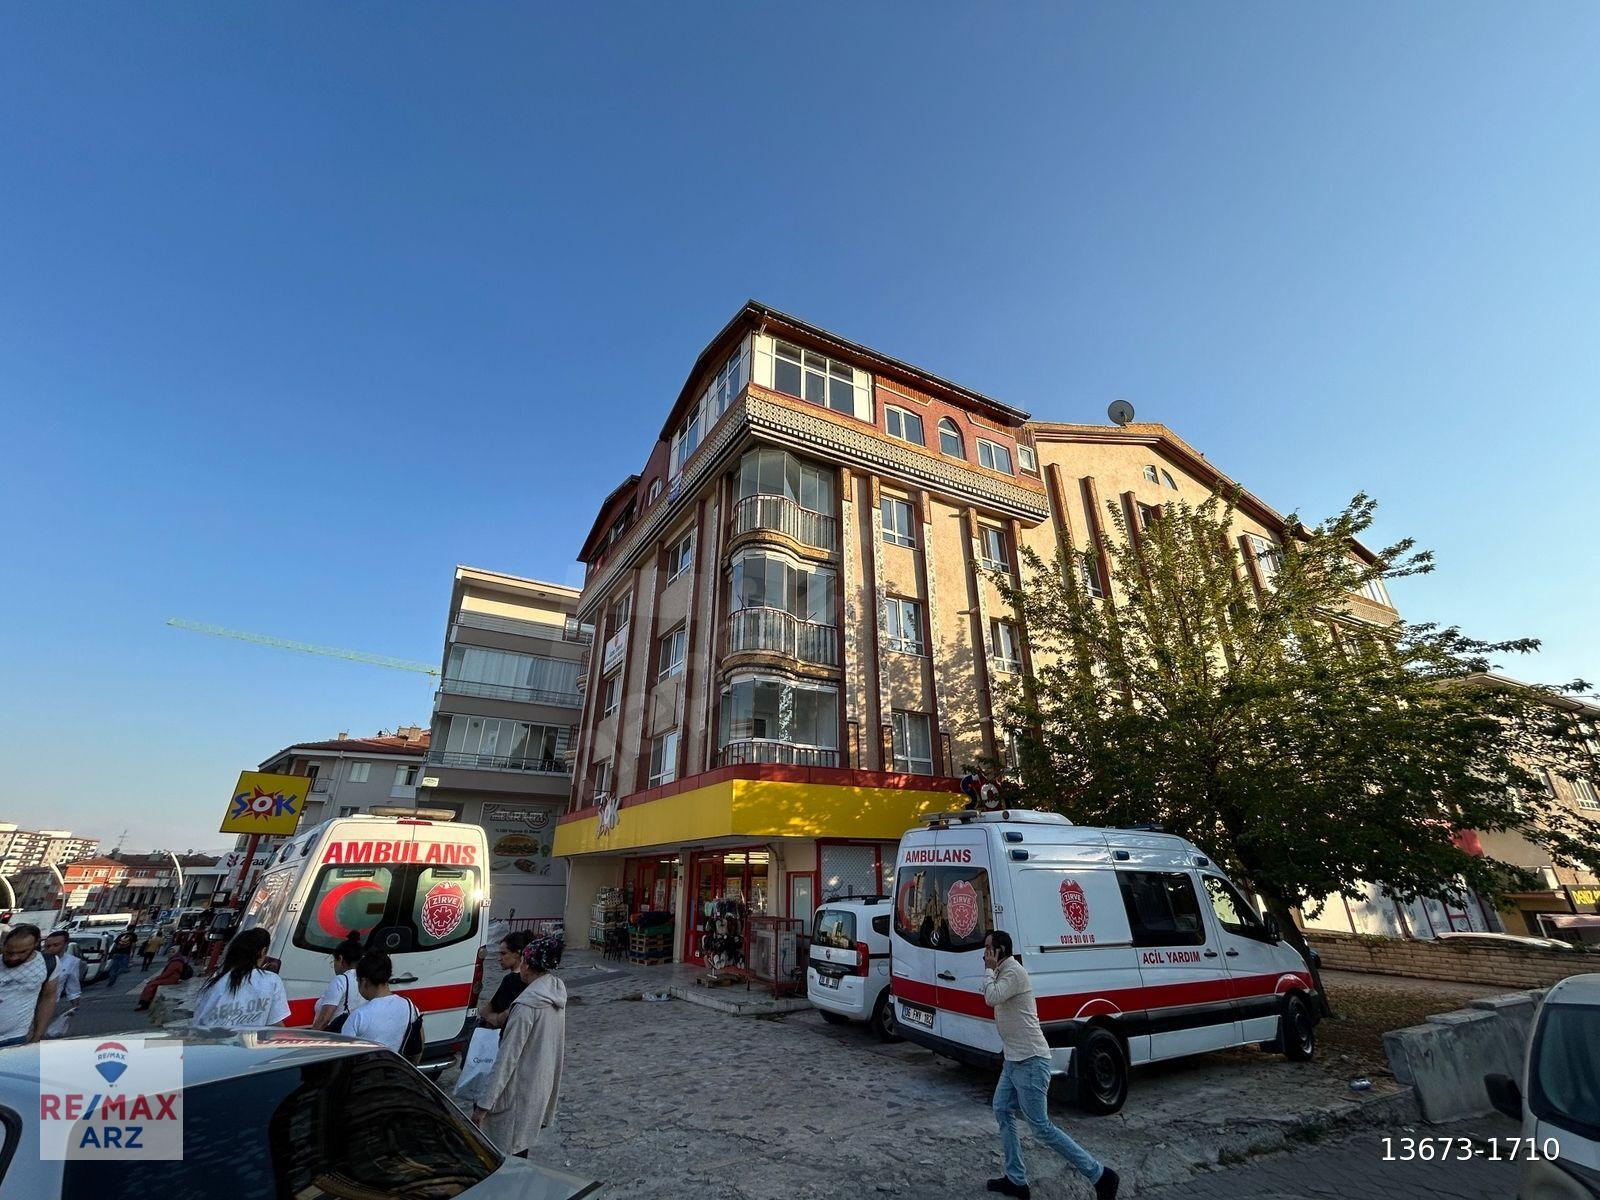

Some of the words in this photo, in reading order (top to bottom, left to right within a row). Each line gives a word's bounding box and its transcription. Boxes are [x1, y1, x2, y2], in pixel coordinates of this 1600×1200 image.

[231, 789, 298, 820] ŞOK
[321, 840, 476, 864] AMBULANS
[905, 848, 971, 863] AMBULANS
[1143, 949, 1164, 964] ACİL
[1165, 951, 1200, 964] YARDIM
